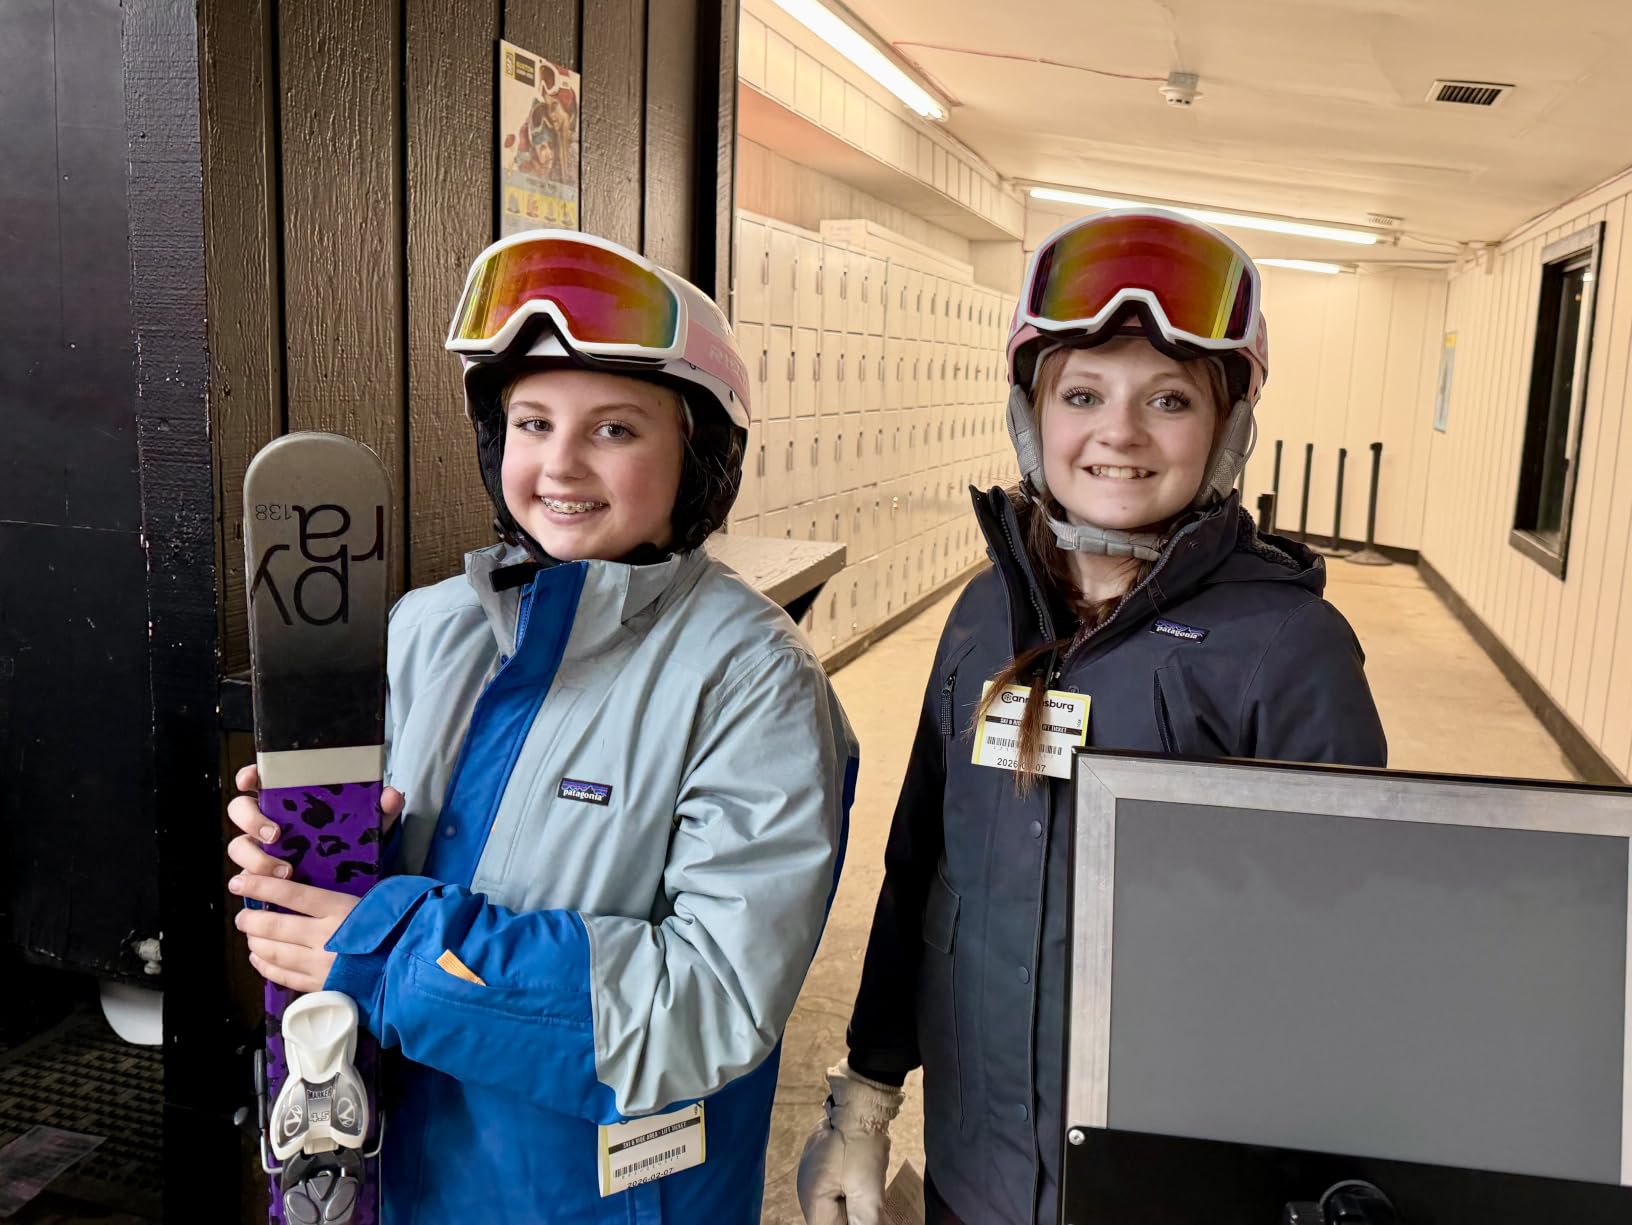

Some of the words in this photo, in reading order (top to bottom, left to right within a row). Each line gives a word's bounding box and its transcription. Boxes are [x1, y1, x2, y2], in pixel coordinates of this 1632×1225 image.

[255, 504, 292, 520] 138
[1156, 626, 1198, 639] patagonia
[1001, 691, 1075, 713] Cannsburg
[563, 789, 603, 801] patagonia
[307, 1087, 333, 1100] MARKER
[628, 1167, 673, 1187] 2026-02-07
